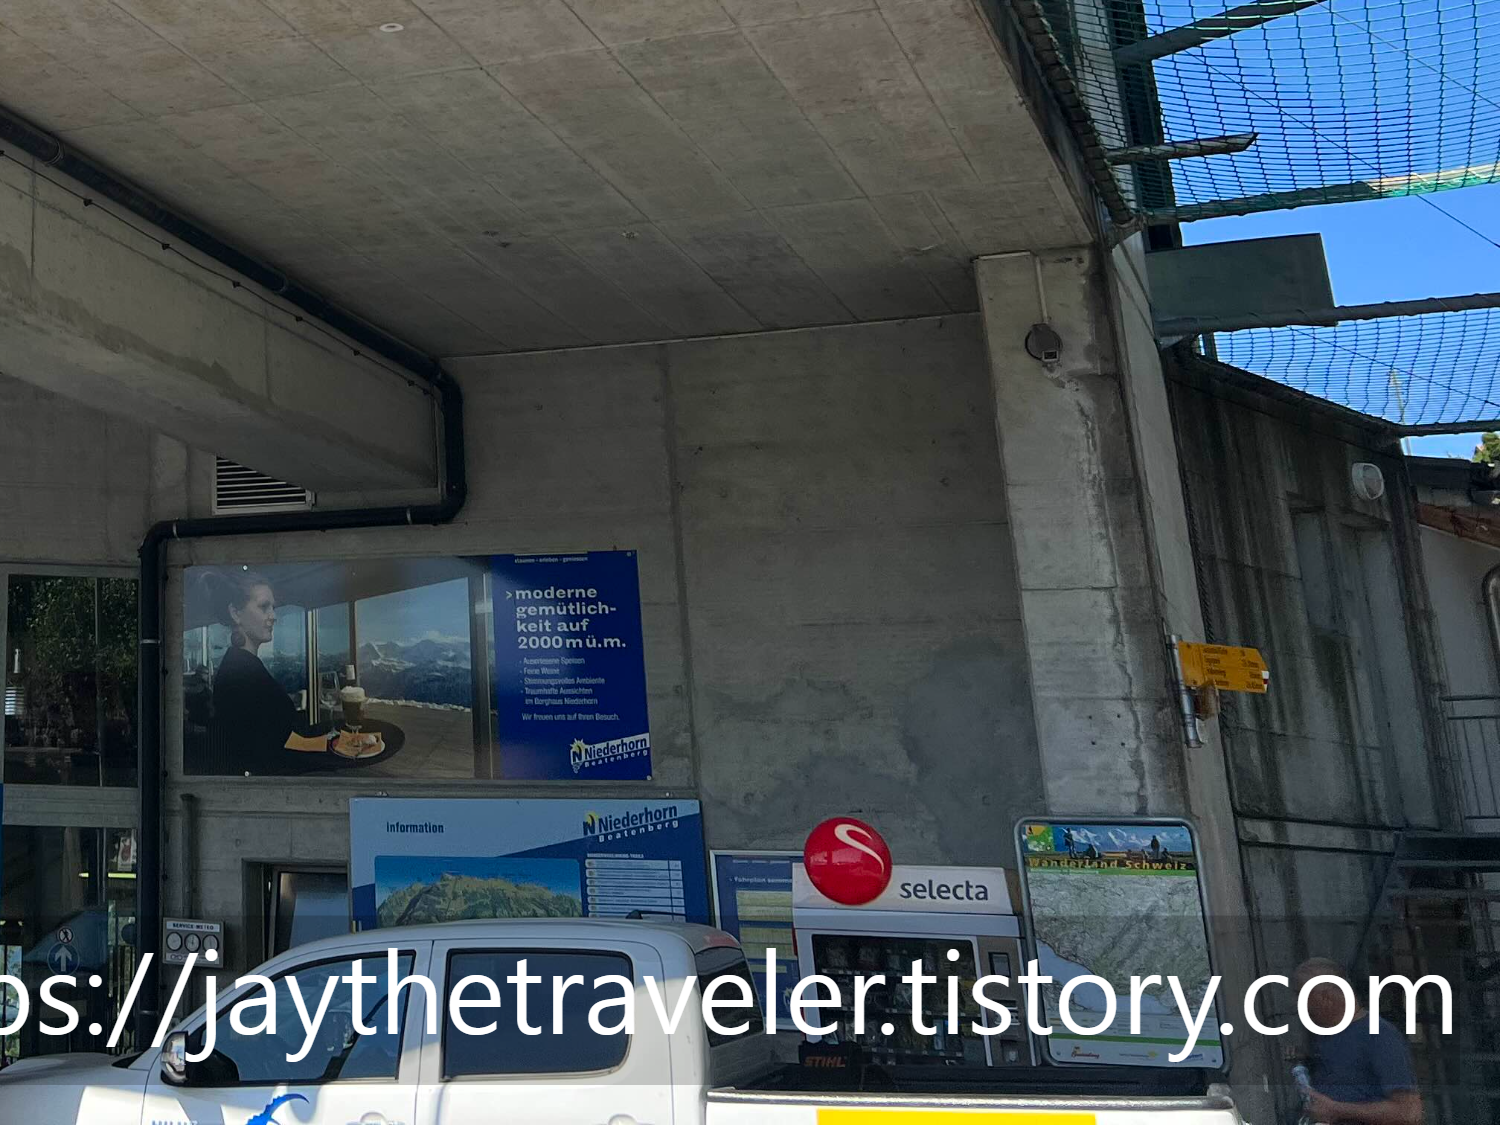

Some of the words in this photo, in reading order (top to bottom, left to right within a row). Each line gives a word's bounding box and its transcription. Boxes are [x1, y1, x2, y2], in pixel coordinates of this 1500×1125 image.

[515, 586, 598, 600] moderne
[516, 601, 616, 619] gemütlich-
[516, 619, 552, 632] keit
[557, 618, 590, 632] auf
[518, 635, 563, 649] 2000
[565, 637, 583, 648] m
[584, 737, 647, 760] Niederhorn
[584, 749, 648, 767] Beatenberg
[386, 821, 444, 833] Information
[598, 805, 678, 833] Niederhorn
[599, 820, 679, 843] Beatenberg
[1029, 858, 1118, 869] Wanderland
[1125, 859, 1188, 870] Schweiz
[900, 879, 989, 901] selecta
[804, 1056, 847, 1068] STIHL
